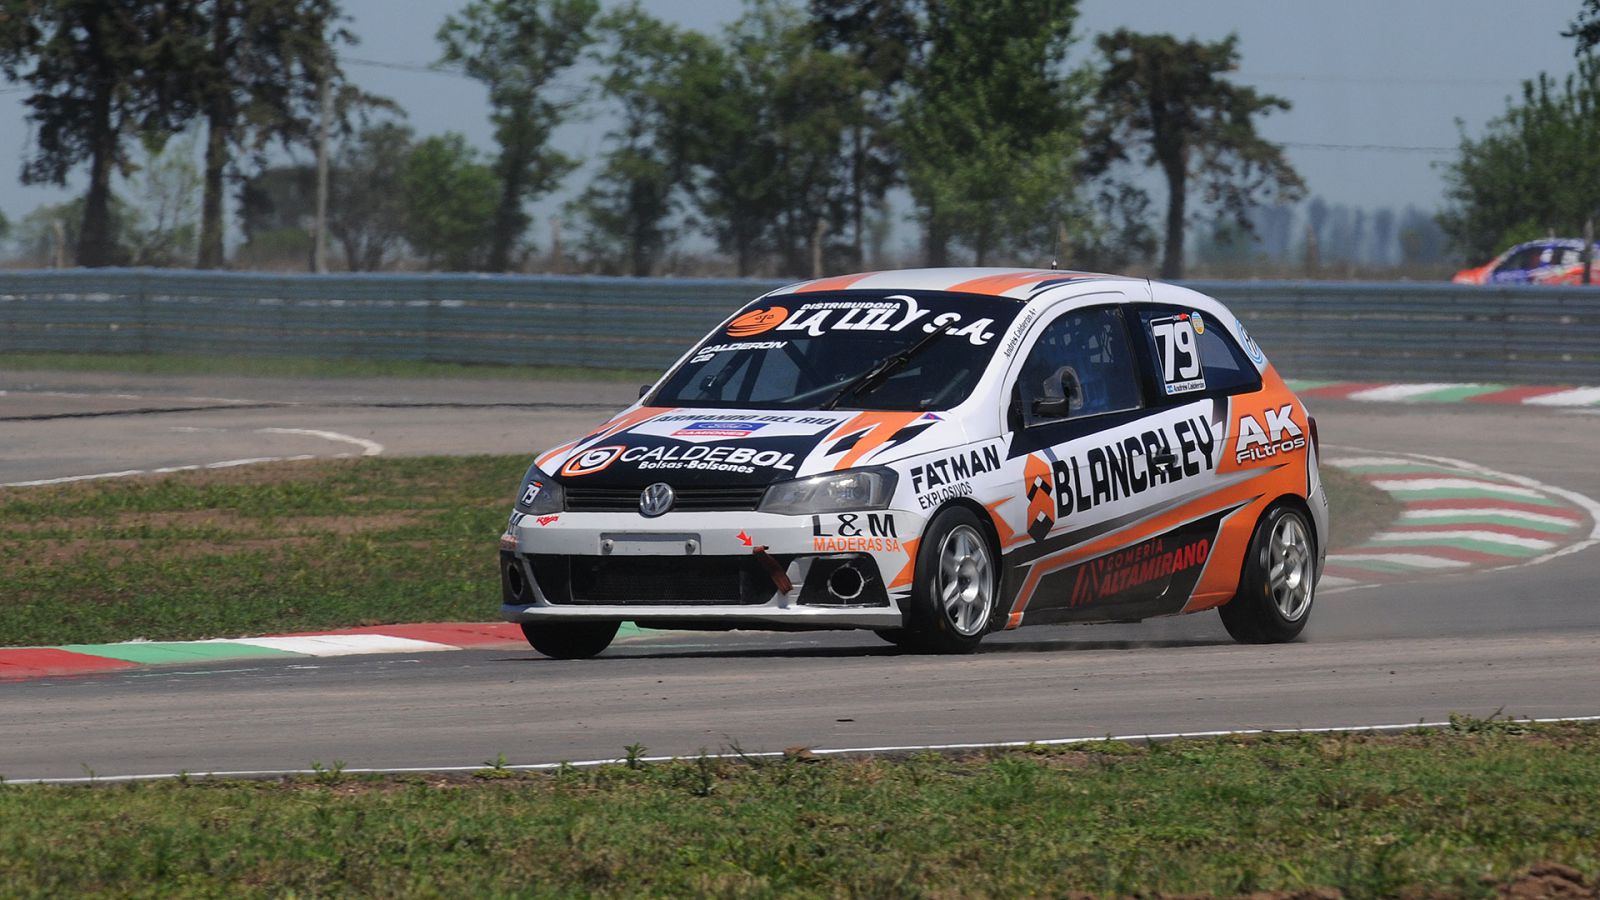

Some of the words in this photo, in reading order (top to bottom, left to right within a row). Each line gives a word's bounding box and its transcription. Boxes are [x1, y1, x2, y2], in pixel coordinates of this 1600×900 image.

[776, 308, 832, 337] LA
[831, 295, 929, 332] LILY
[800, 299, 901, 311] DISTRIBUIDORA
[697, 341, 788, 355] CALDERON
[1153, 320, 1200, 382] 79
[653, 414, 753, 423] ARMANDO
[755, 415, 793, 424] DEL
[795, 416, 838, 426] RIO
[1235, 403, 1303, 453] AK
[620, 445, 796, 472] CALDEBOL
[910, 444, 1002, 494] FATMAN
[521, 484, 540, 504] 79
[918, 481, 973, 510] EXPLOSIVOS
[813, 537, 885, 553] MADERAS
[885, 539, 902, 554] SA
[1099, 538, 1209, 598] ALTAMIRANO
